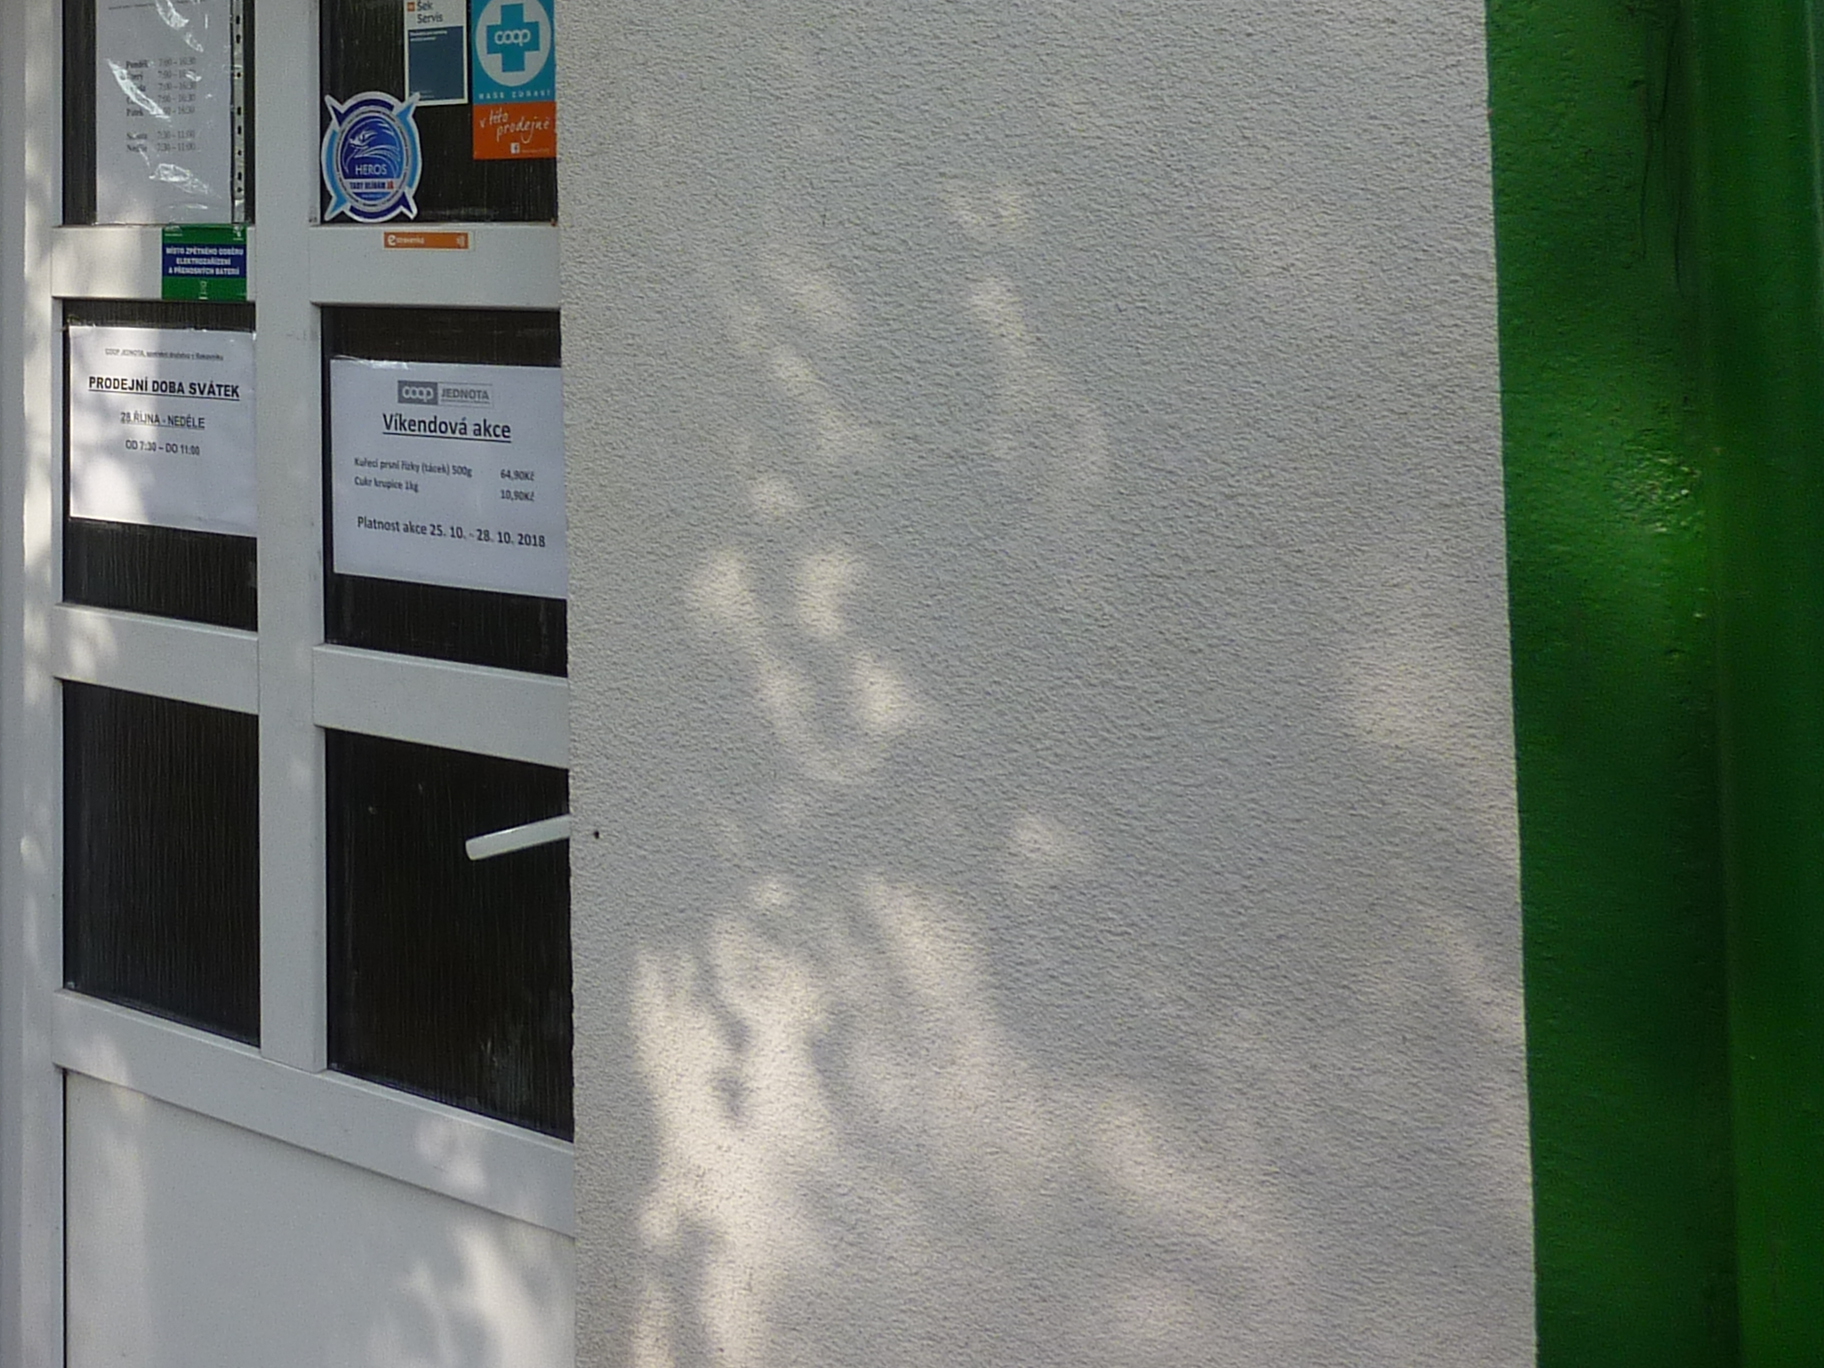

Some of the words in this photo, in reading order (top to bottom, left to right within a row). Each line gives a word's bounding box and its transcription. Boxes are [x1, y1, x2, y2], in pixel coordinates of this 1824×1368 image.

[494, 29, 532, 47] coop
[354, 163, 388, 176] HEROS
[88, 376, 148, 392] PRODEJNÍ
[152, 380, 185, 395] DOBA
[188, 380, 240, 399] SVÁTEK
[401, 386, 435, 402] coop
[440, 387, 490, 400] JEDNOTA
[167, 413, 206, 429] NEDĚLE
[382, 412, 468, 436] Víkendová
[472, 418, 512, 439] akce
[125, 439, 138, 451] OD
[164, 442, 179, 454] DO
[356, 515, 401, 532] Platnost
[402, 520, 427, 535] akce
[429, 523, 447, 537] 25.
[449, 525, 467, 540] 10.
[476, 528, 494, 543] 28.
[497, 530, 514, 545] 10.
[517, 533, 546, 548] 2018
